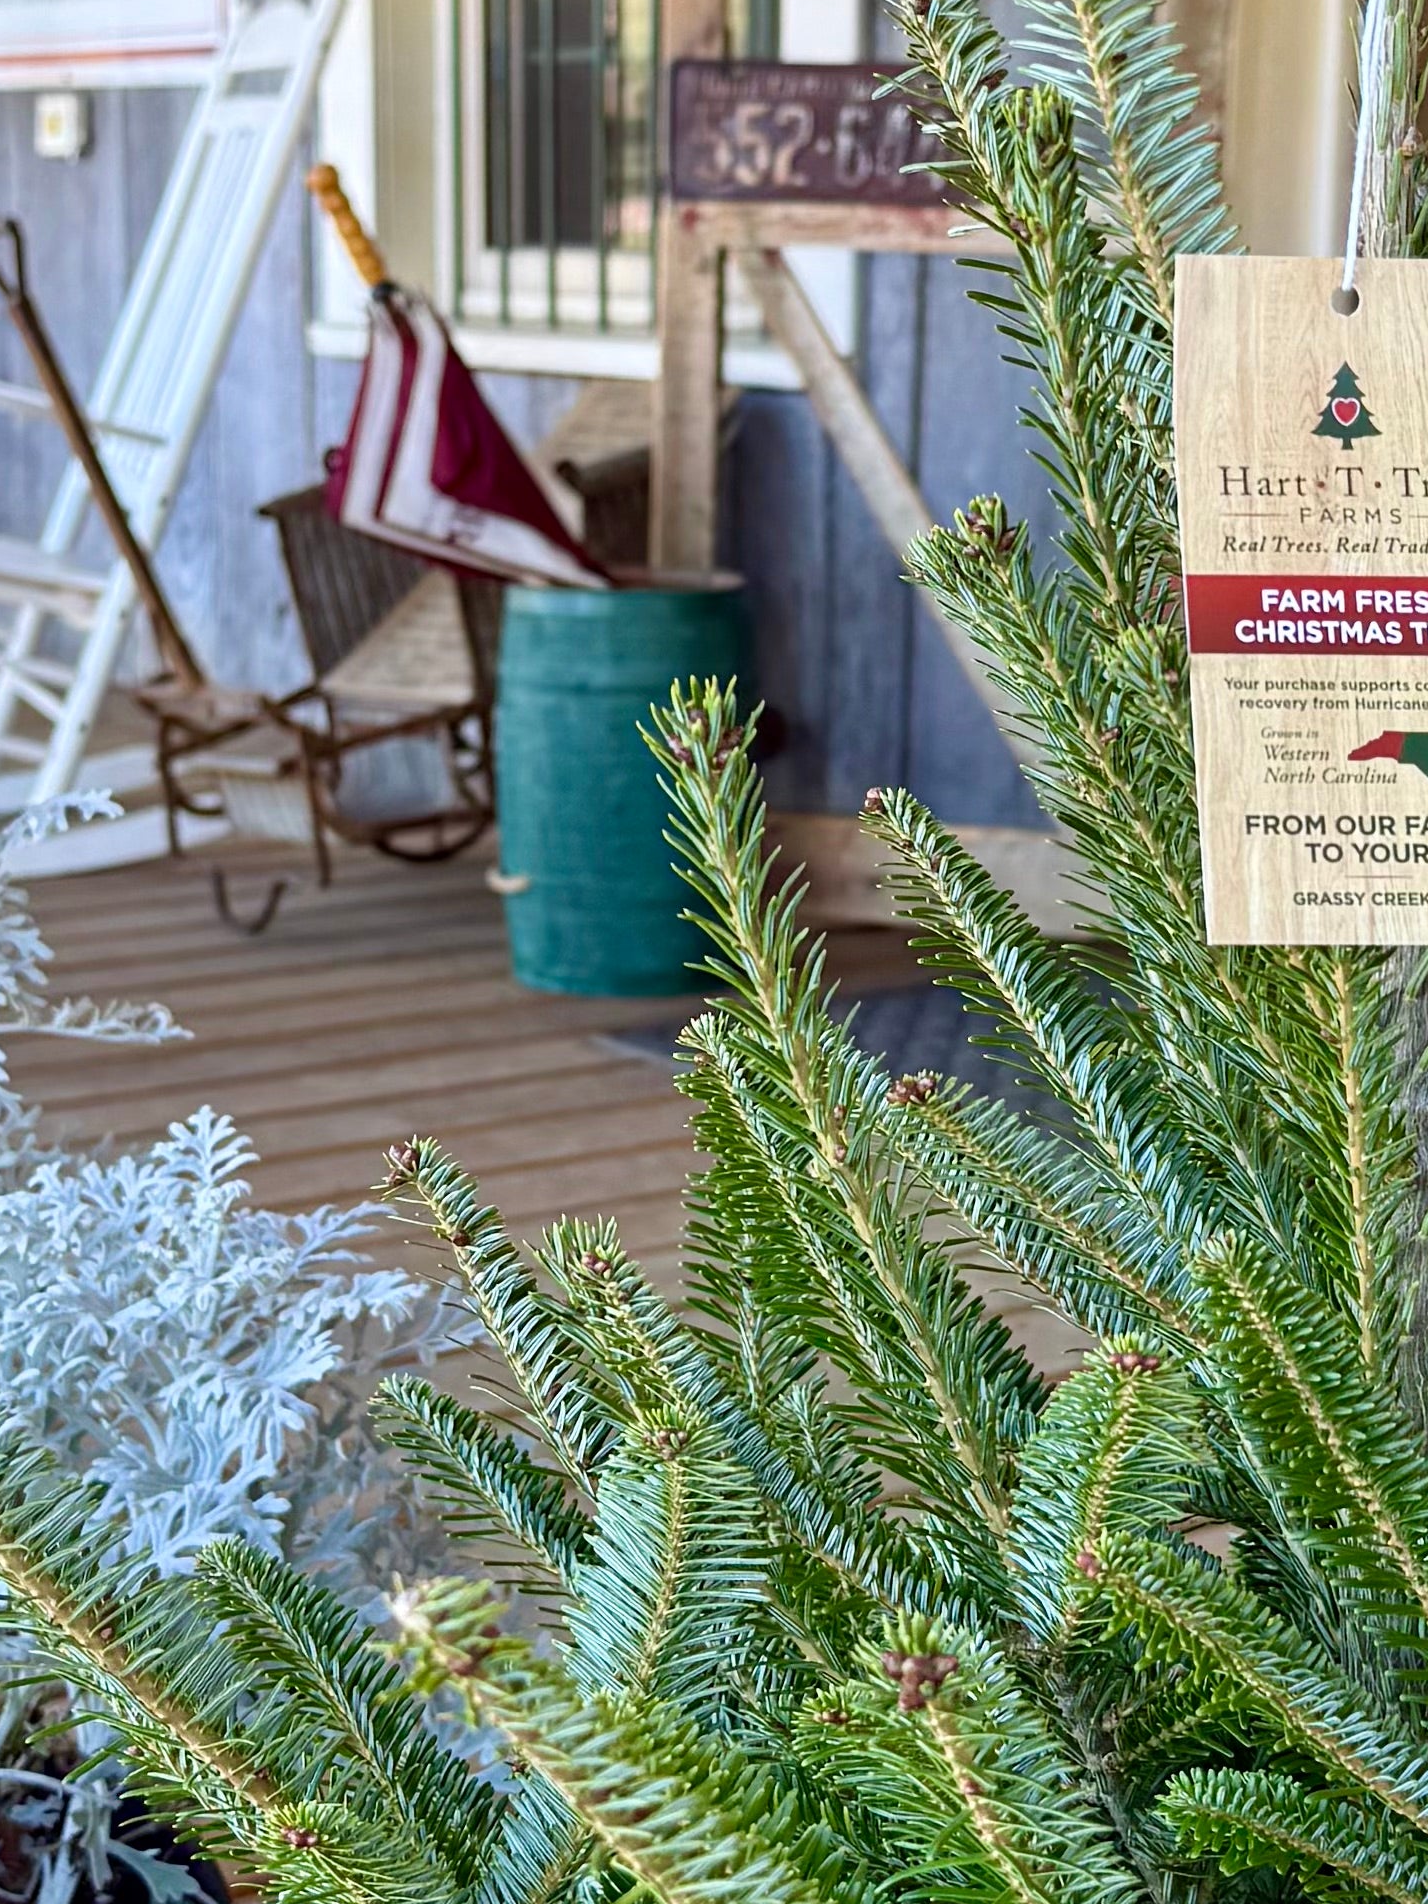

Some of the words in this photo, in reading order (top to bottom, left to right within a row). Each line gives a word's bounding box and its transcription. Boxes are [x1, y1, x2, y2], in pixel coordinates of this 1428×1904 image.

[1299, 507, 1403, 525] FARMS
[1222, 535, 1267, 554] Real
[1272, 535, 1329, 554] Trees.
[1335, 536, 1379, 555] Real
[1261, 589, 1346, 614] FARM
[1234, 619, 1404, 646] CHRISTMAS
[1224, 677, 1260, 692] Your
[1264, 677, 1337, 695] purchase
[1340, 679, 1411, 696] supports
[1239, 698, 1309, 714] recovery
[1313, 697, 1351, 711] from
[1260, 726, 1303, 740] Grown
[1263, 745, 1330, 762] Western
[1263, 767, 1315, 785] North
[1322, 767, 1398, 785] Carolina
[1245, 815, 1327, 836] FROM
[1335, 815, 1396, 836] OUR
[1305, 842, 1344, 864] TO
[1292, 891, 1366, 907] GRASSY
